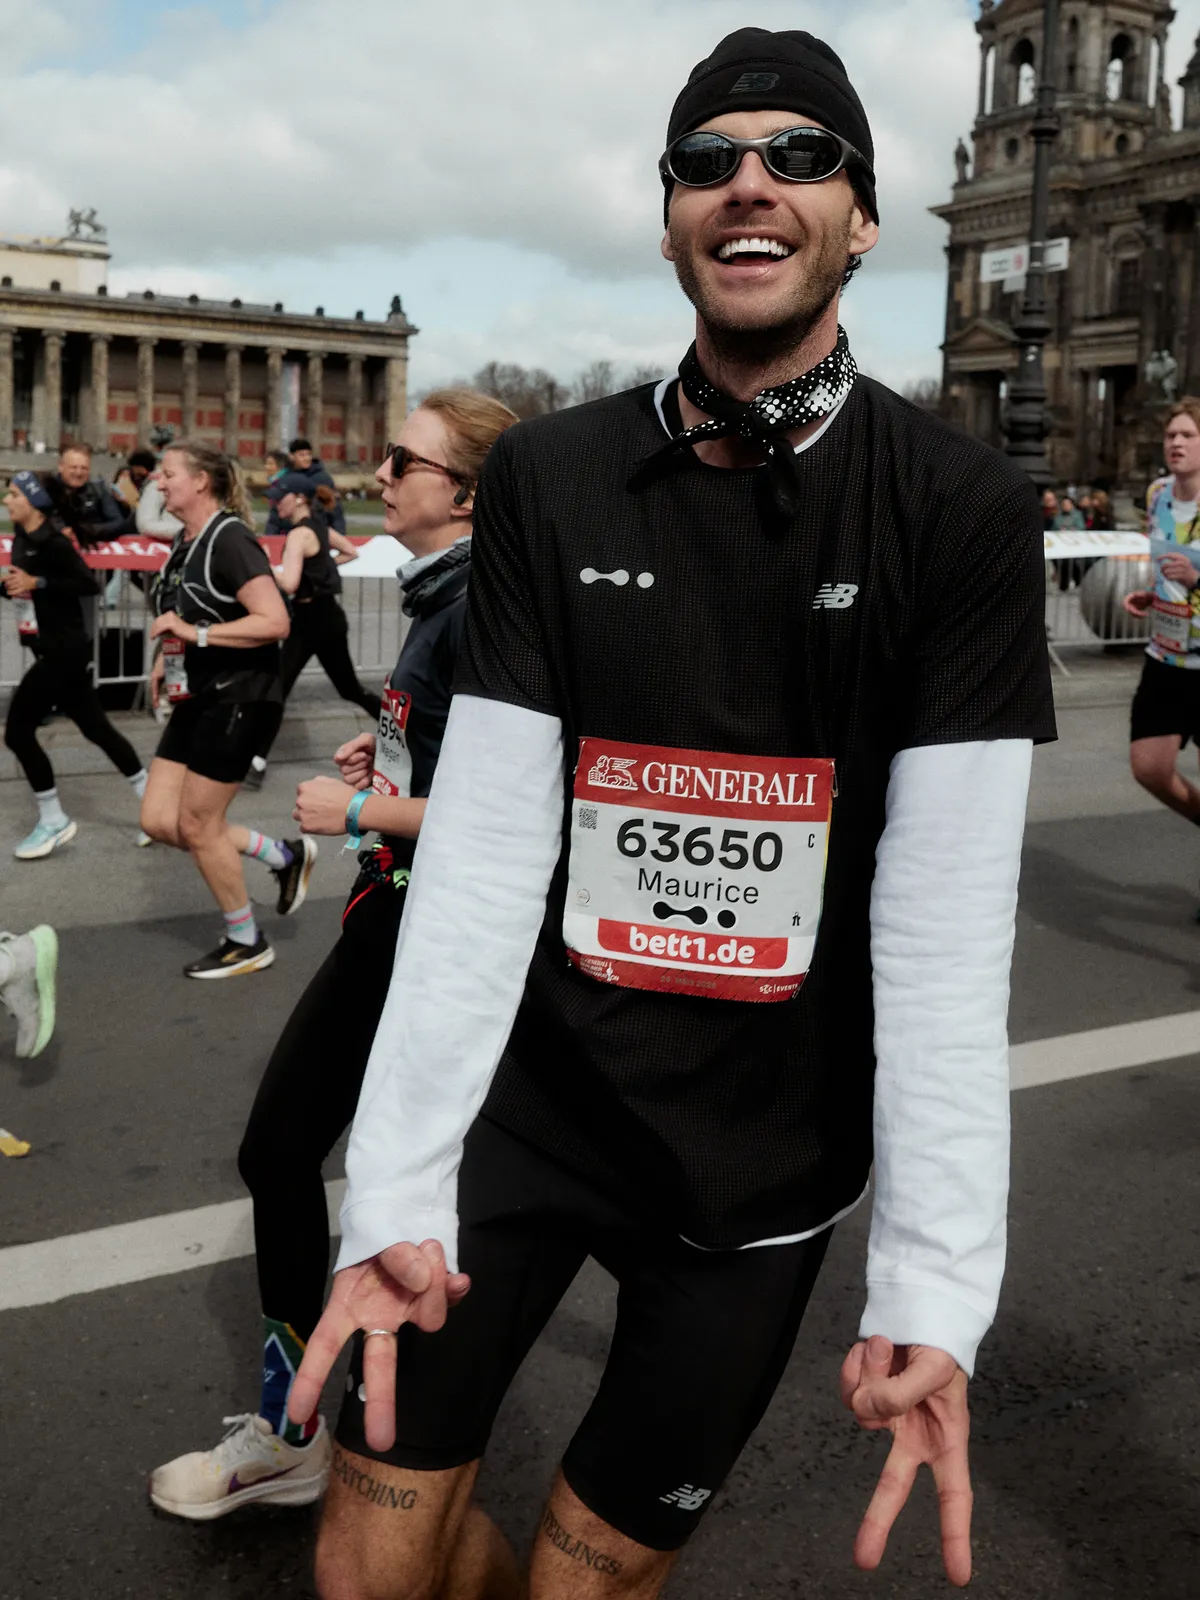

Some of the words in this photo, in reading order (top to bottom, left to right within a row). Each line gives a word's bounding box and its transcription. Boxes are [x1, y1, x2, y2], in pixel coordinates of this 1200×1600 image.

[642, 761, 817, 806] GENERALI
[617, 818, 783, 872] 63650
[807, 833, 815, 849] C
[637, 868, 759, 904] Maurice
[629, 926, 756, 964] bett1.de
[332, 1450, 417, 1510] CATCHING
